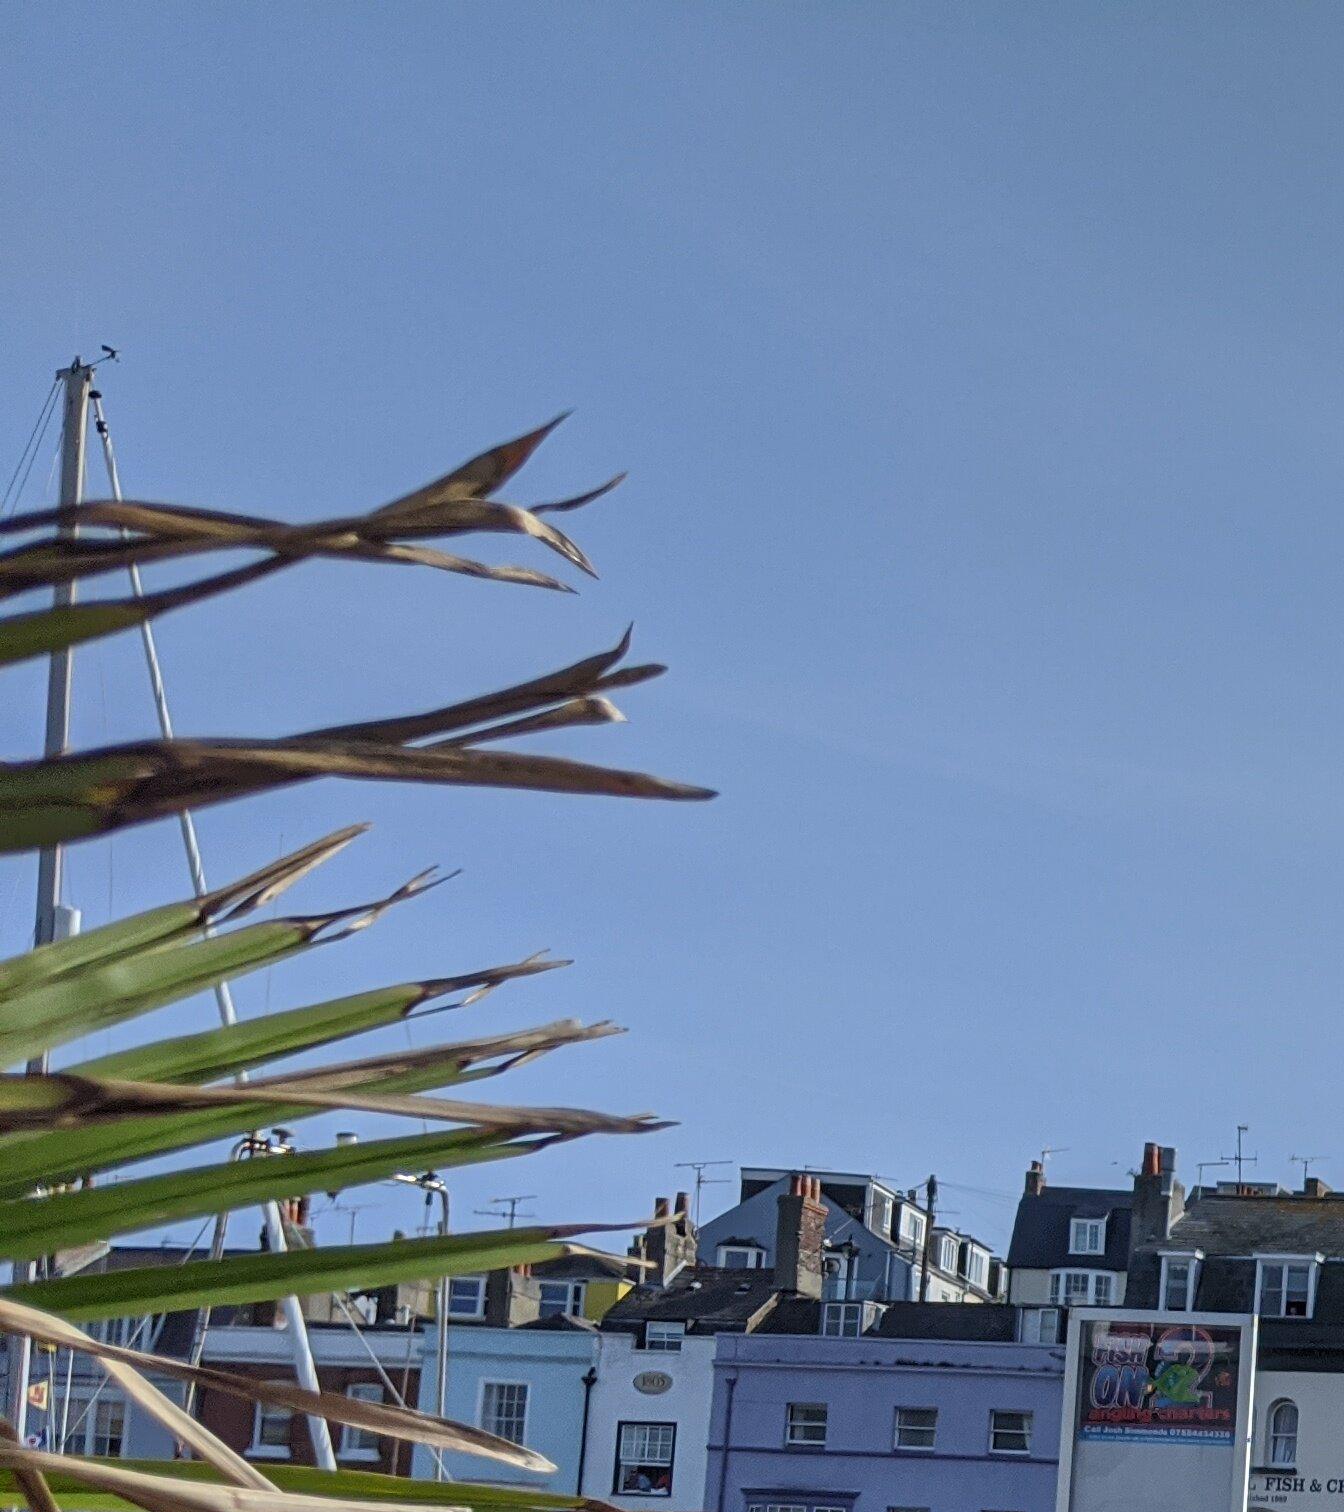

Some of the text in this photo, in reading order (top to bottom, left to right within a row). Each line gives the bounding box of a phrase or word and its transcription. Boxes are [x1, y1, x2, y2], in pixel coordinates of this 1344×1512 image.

[1090, 1363, 1150, 1409] ON
[1265, 1477, 1305, 1492] FISH
[1310, 1479, 1322, 1492] &
